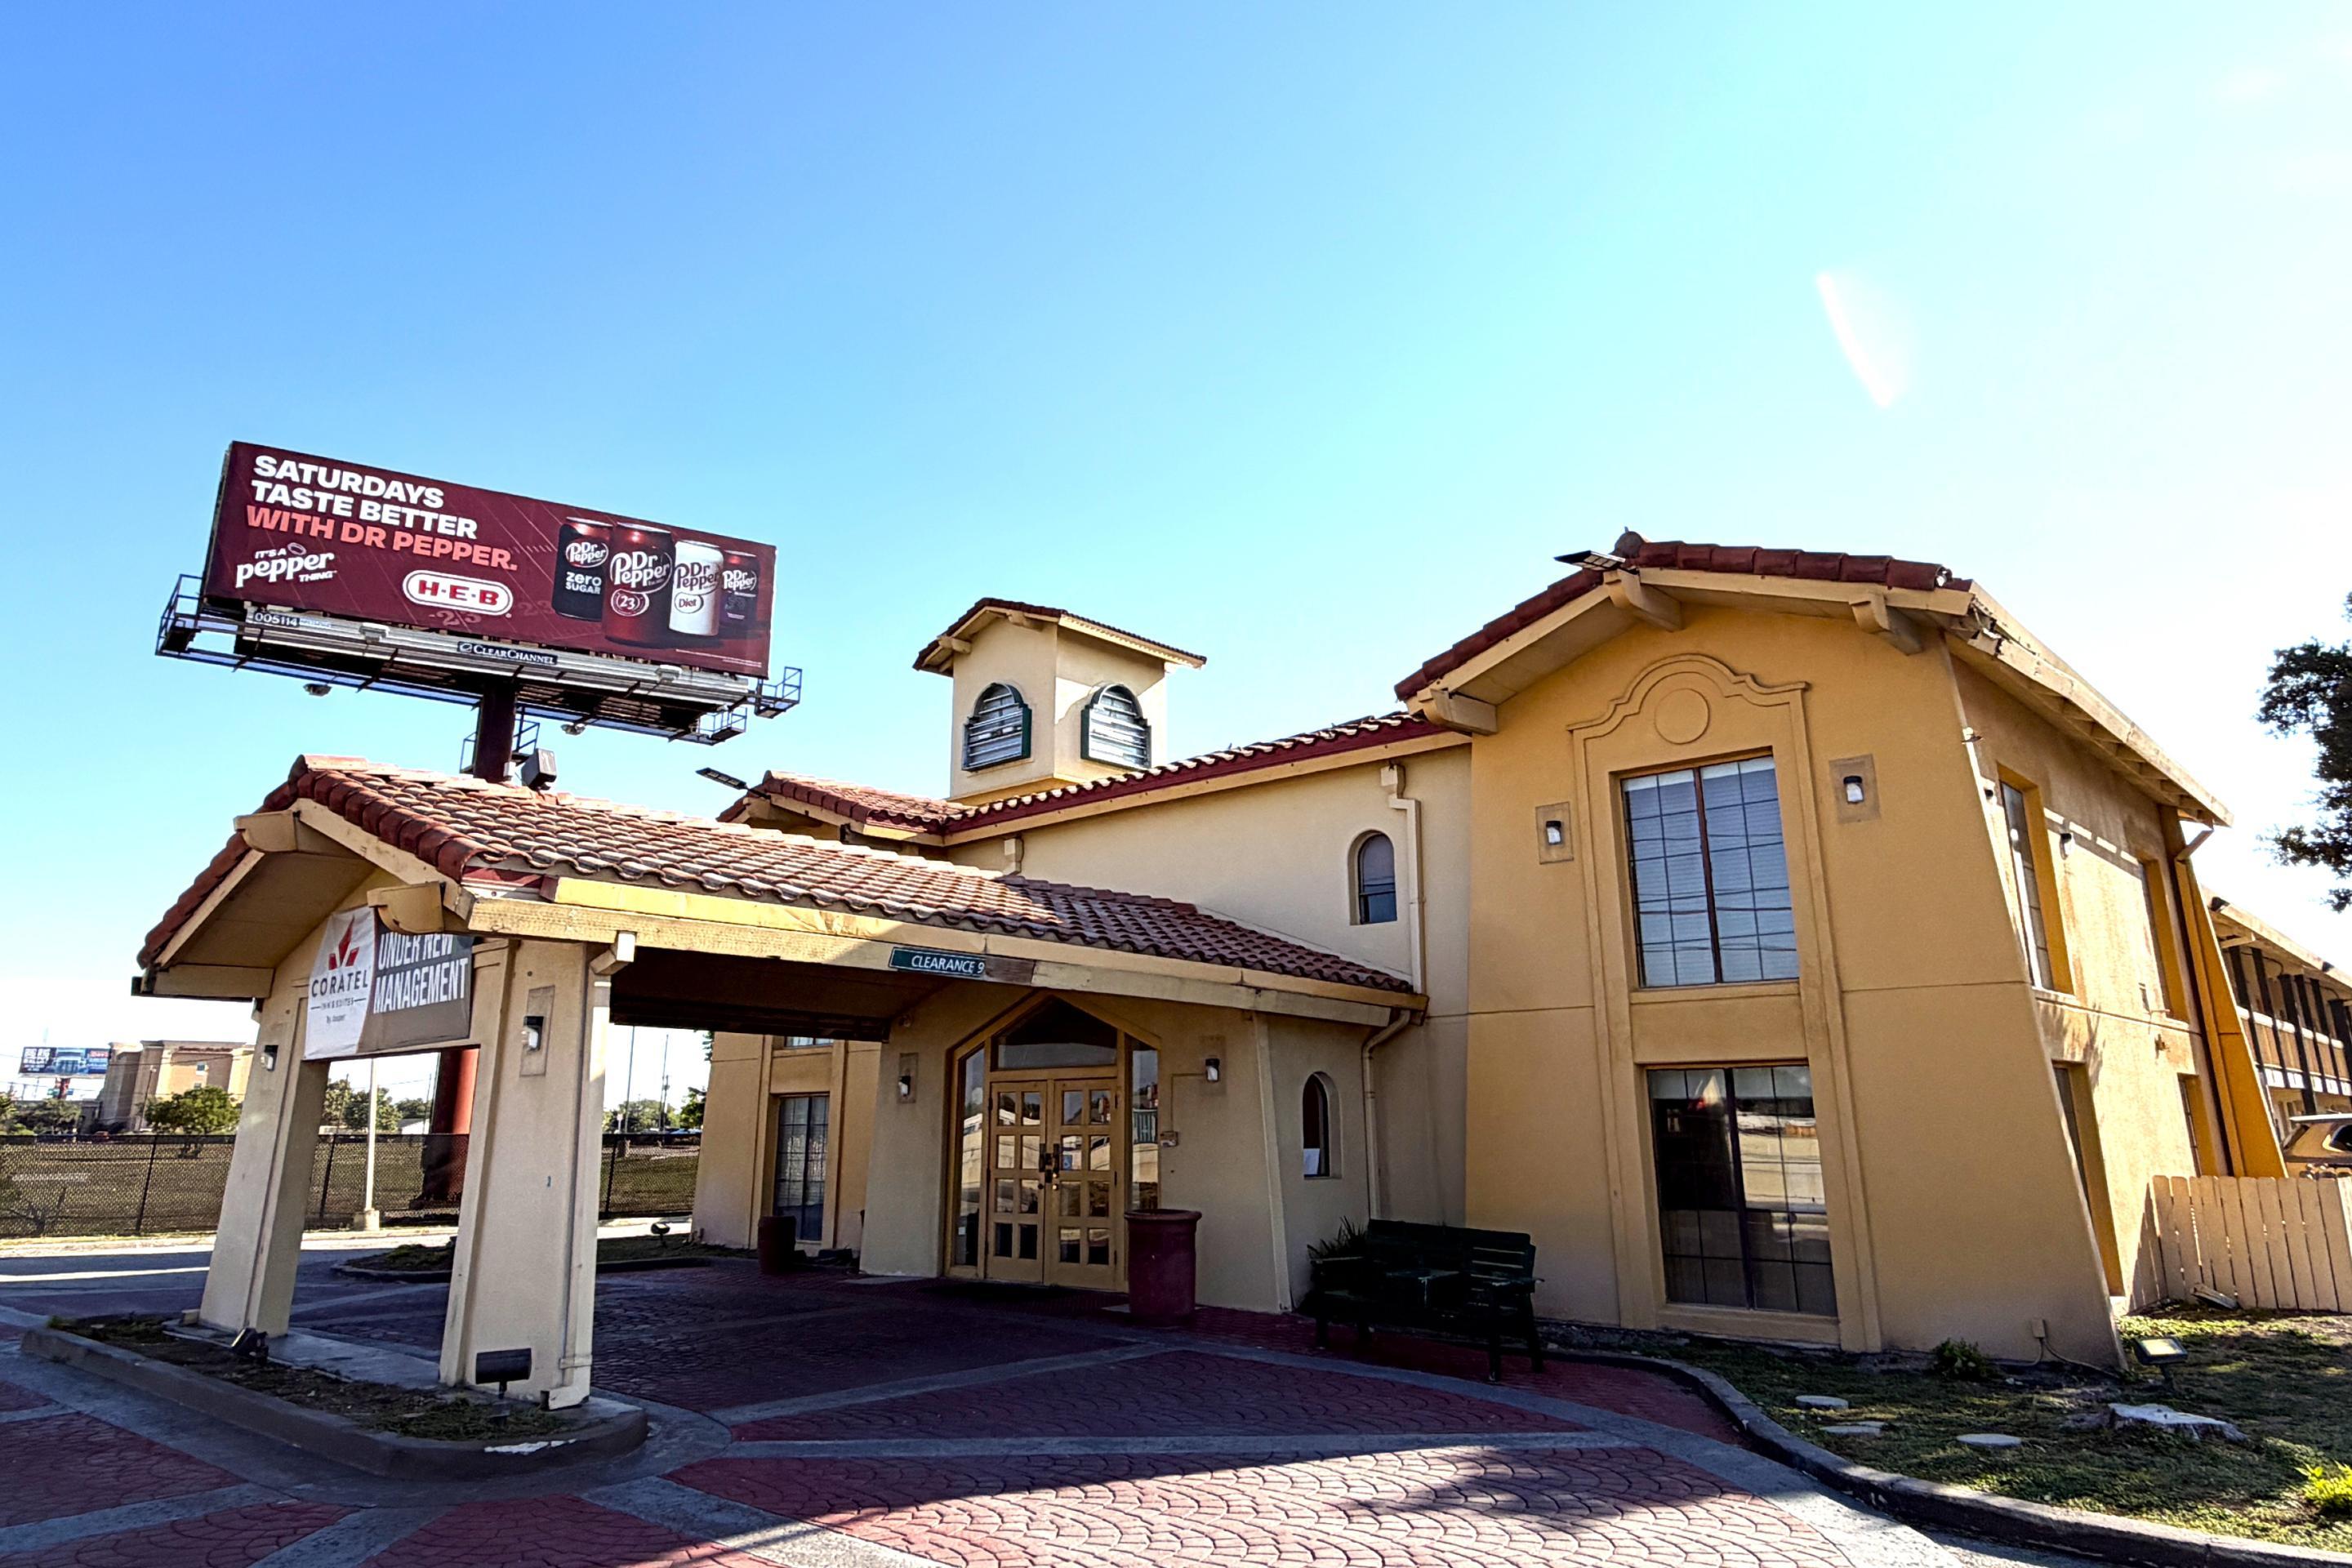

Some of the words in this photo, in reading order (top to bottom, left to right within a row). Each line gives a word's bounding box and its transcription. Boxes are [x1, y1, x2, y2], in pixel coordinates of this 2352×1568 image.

[253, 455, 444, 508] SATURDAYS
[251, 479, 354, 517] TASTE
[359, 500, 478, 539] BETTER
[247, 505, 336, 539] WITH
[340, 521, 386, 549] DR
[392, 531, 519, 571] PEPPER.
[581, 541, 598, 552] Dr
[568, 542, 606, 564] Pepper
[632, 551, 658, 569] Dr
[235, 553, 335, 588] pepper
[612, 552, 670, 588] Pepper
[676, 564, 718, 591] Pepper
[690, 562, 710, 573] Dr
[733, 569, 748, 580] Dr
[565, 581, 602, 595] SUGAR
[566, 572, 602, 586] zero
[723, 570, 755, 590] Pepper
[620, 595, 636, 610] 23
[679, 599, 697, 608] Diet
[255, 613, 298, 627] 005114
[378, 932, 421, 970] UNDER
[422, 933, 453, 960] NEW
[911, 955, 976, 974] CLEARANCE
[977, 961, 985, 974] 9
[311, 969, 368, 998] CORATEL
[373, 957, 469, 1014] MANAGEMENT
